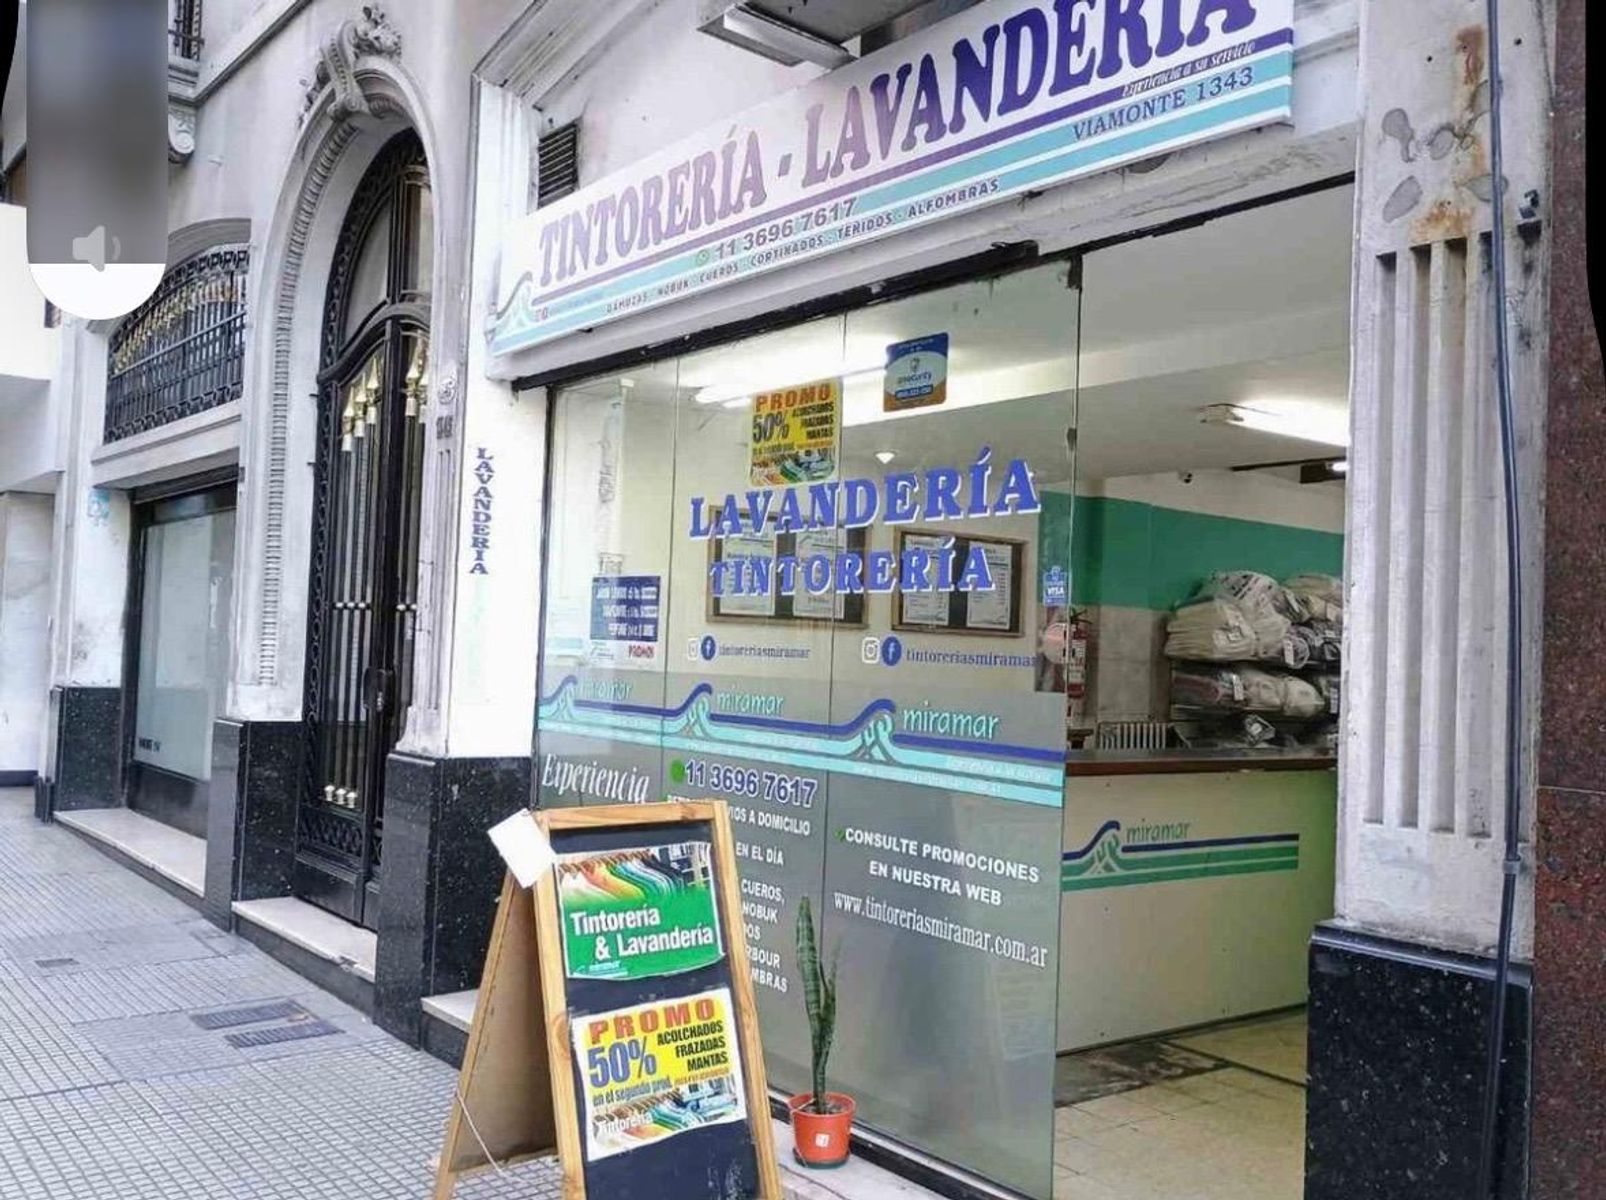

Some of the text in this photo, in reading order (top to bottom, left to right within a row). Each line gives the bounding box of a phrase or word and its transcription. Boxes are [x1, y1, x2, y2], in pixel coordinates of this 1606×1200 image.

[1193, 56, 1209, 72] su
[1211, 41, 1255, 66] servicio
[1073, 67, 1253, 140] VIAMONTE 1343
[539, 124, 767, 287] TINTORERÍA
[700, 263, 739, 283] CUEROS
[751, 235, 823, 266] CORTINADOS
[908, 179, 999, 218] ALFOMBRAS
[716, 197, 857, 260] 11 3696 7617
[756, 382, 831, 411] PROMO
[753, 408, 789, 443] 50%
[689, 446, 1041, 540] LAVANDERÍA
[709, 536, 997, 597] TINTORERÍA
[573, 678, 632, 701] ramar
[717, 684, 784, 714] miramar
[903, 700, 999, 739] miramar
[540, 753, 650, 803] Experiencia
[685, 759, 817, 808] 11 3696 7617
[748, 808, 756, 823] A
[758, 812, 811, 836] DOMICILIO
[1126, 818, 1190, 843] miramar
[736, 842, 784, 867] EN EL DÍA
[845, 828, 1040, 884] CONSULTE PROMOCIONES
[869, 860, 1002, 905] EN NUESTRA WEB
[570, 904, 660, 935] Tintorería
[834, 891, 1048, 968] www.tintoreriasmiramar.com.ar
[595, 923, 713, 960] & Lavandería
[589, 998, 715, 1045] PROMO
[657, 1020, 723, 1046] ACOLCHADOS
[587, 1036, 657, 1088] 50%
[675, 1036, 726, 1058] FRAZADAS
[687, 1051, 728, 1072] MANTAS
